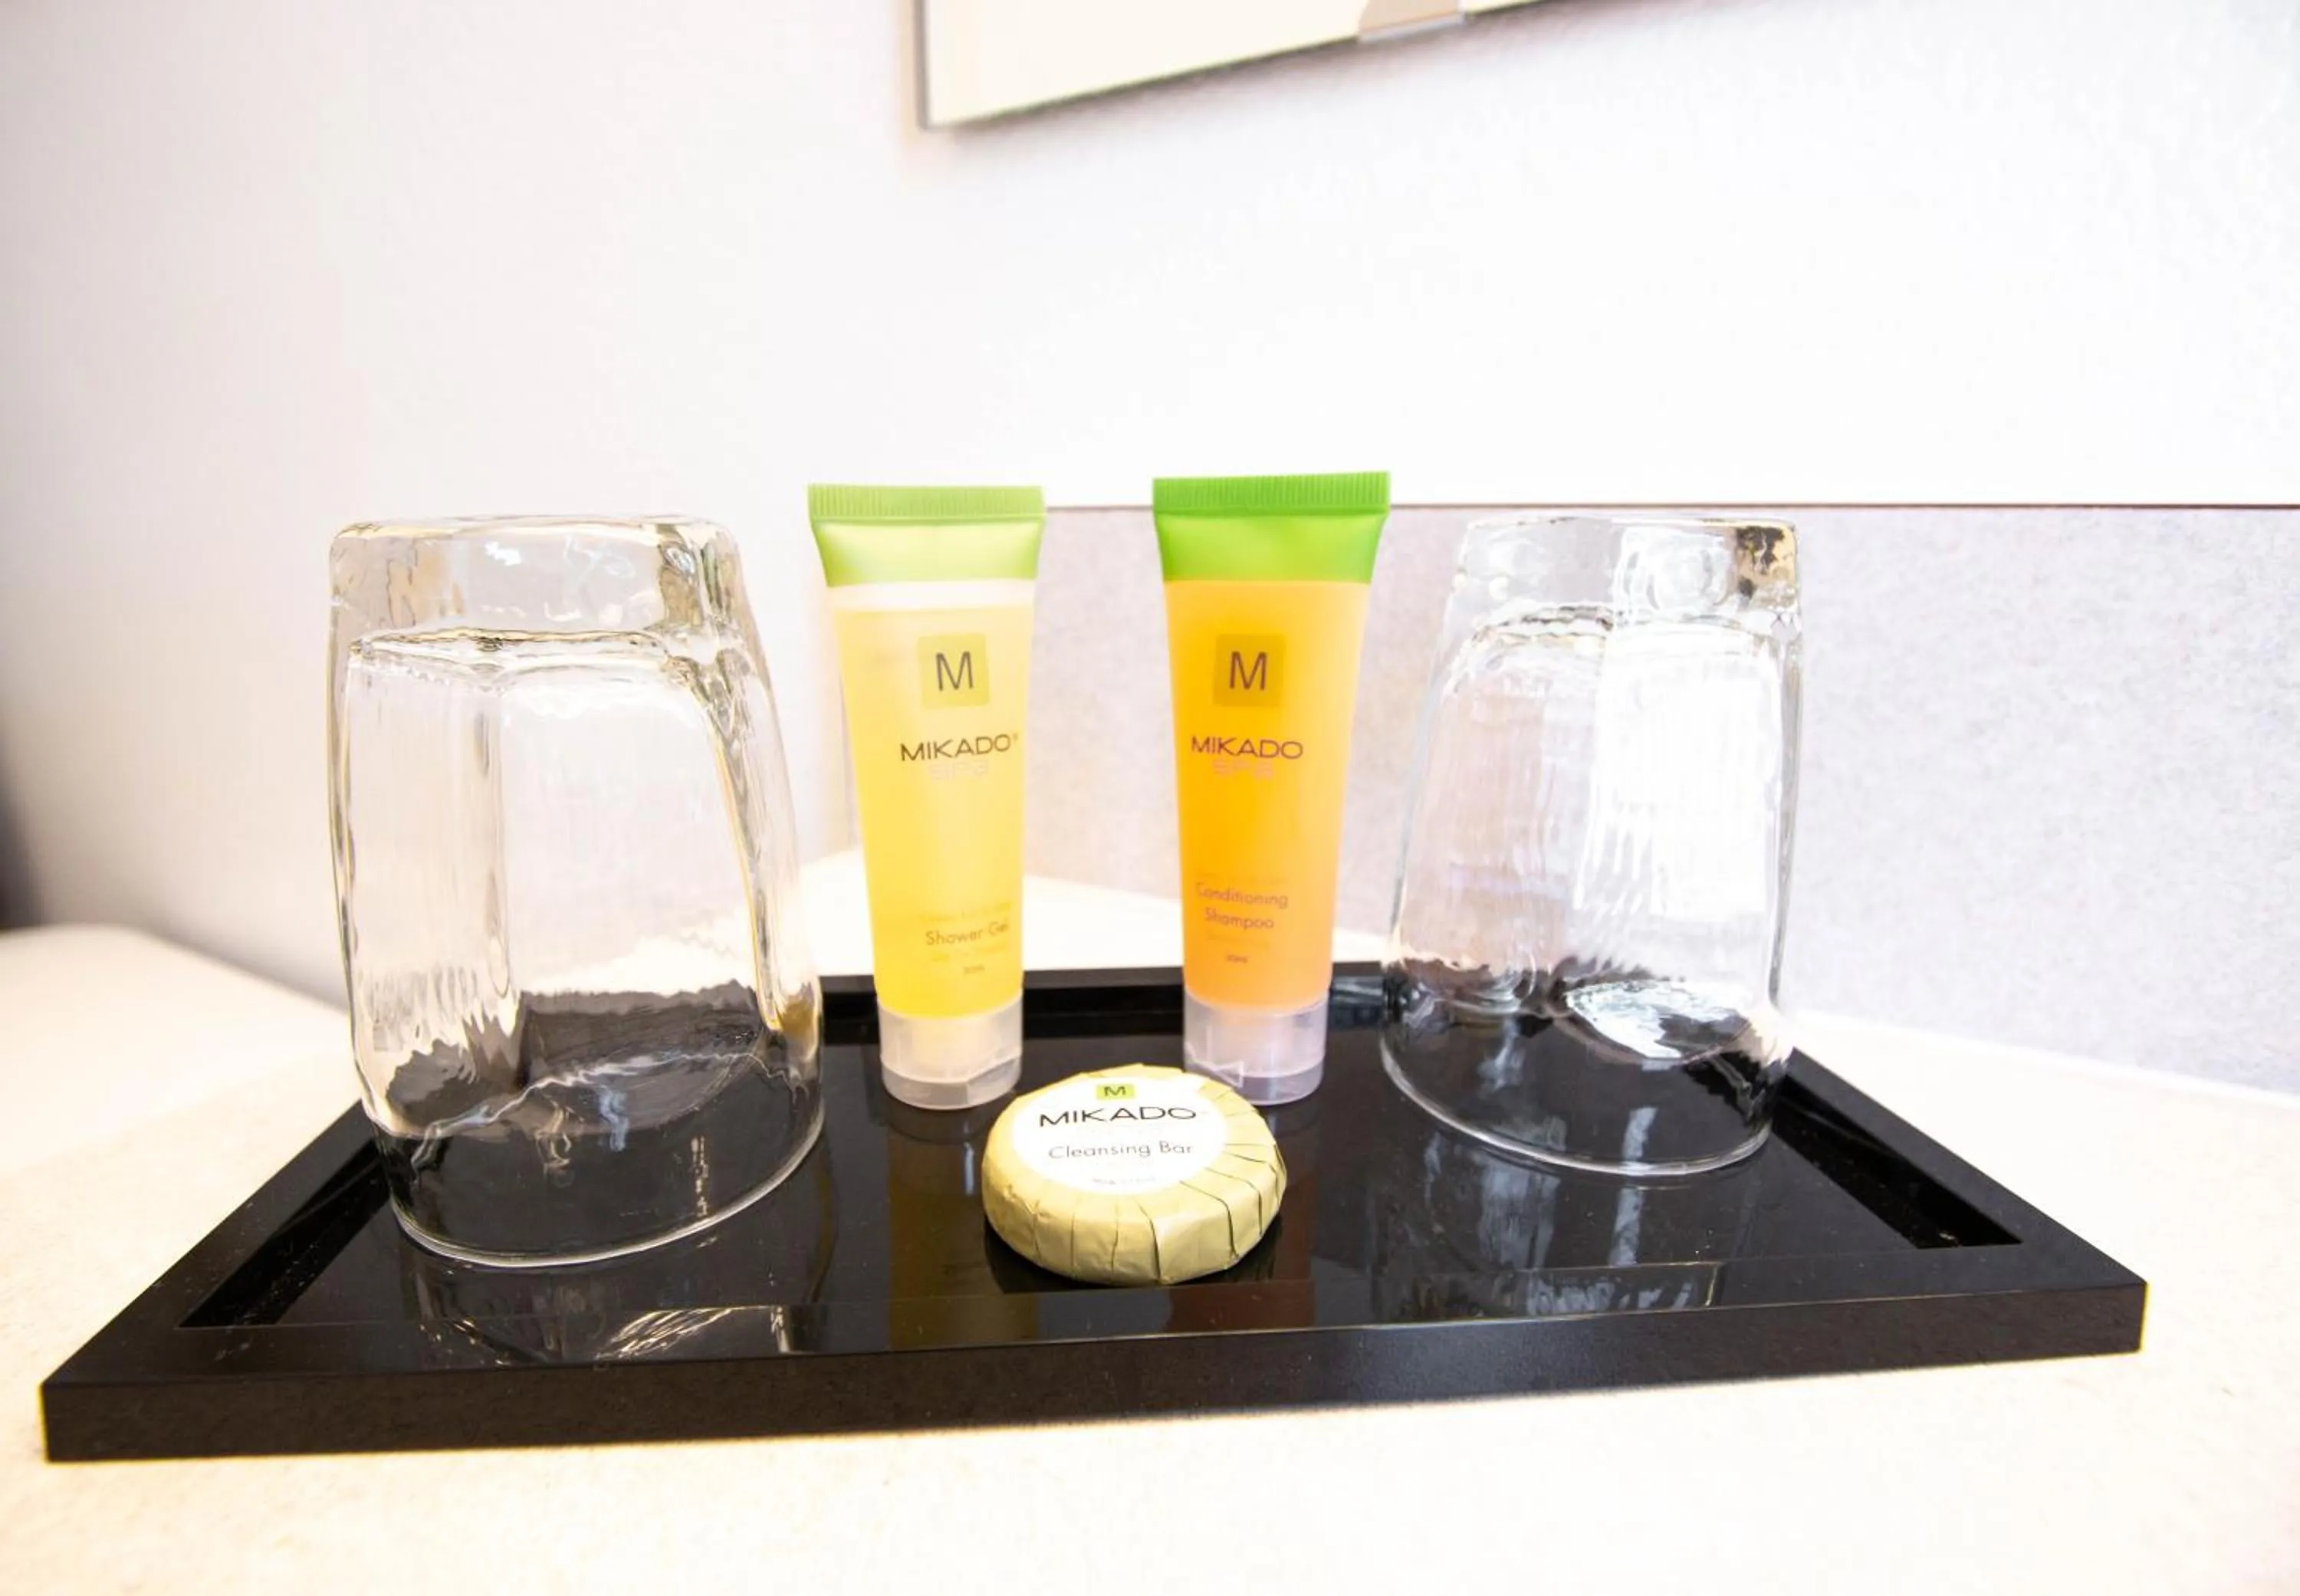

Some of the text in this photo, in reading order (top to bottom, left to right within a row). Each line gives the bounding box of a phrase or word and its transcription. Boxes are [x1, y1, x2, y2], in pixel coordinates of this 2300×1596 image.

[935, 651, 974, 691] M
[1229, 651, 1268, 691] M
[900, 733, 1011, 761] MIKADO
[1191, 735, 1303, 760] MIKADO
[1195, 882, 1289, 909] Conditioning
[1205, 907, 1275, 931] Shampoo
[925, 929, 984, 946] Shower
[1102, 1085, 1127, 1098] M
[1039, 1105, 1198, 1128] MIKADO
[1048, 1140, 1193, 1161] Cleansing Bar
